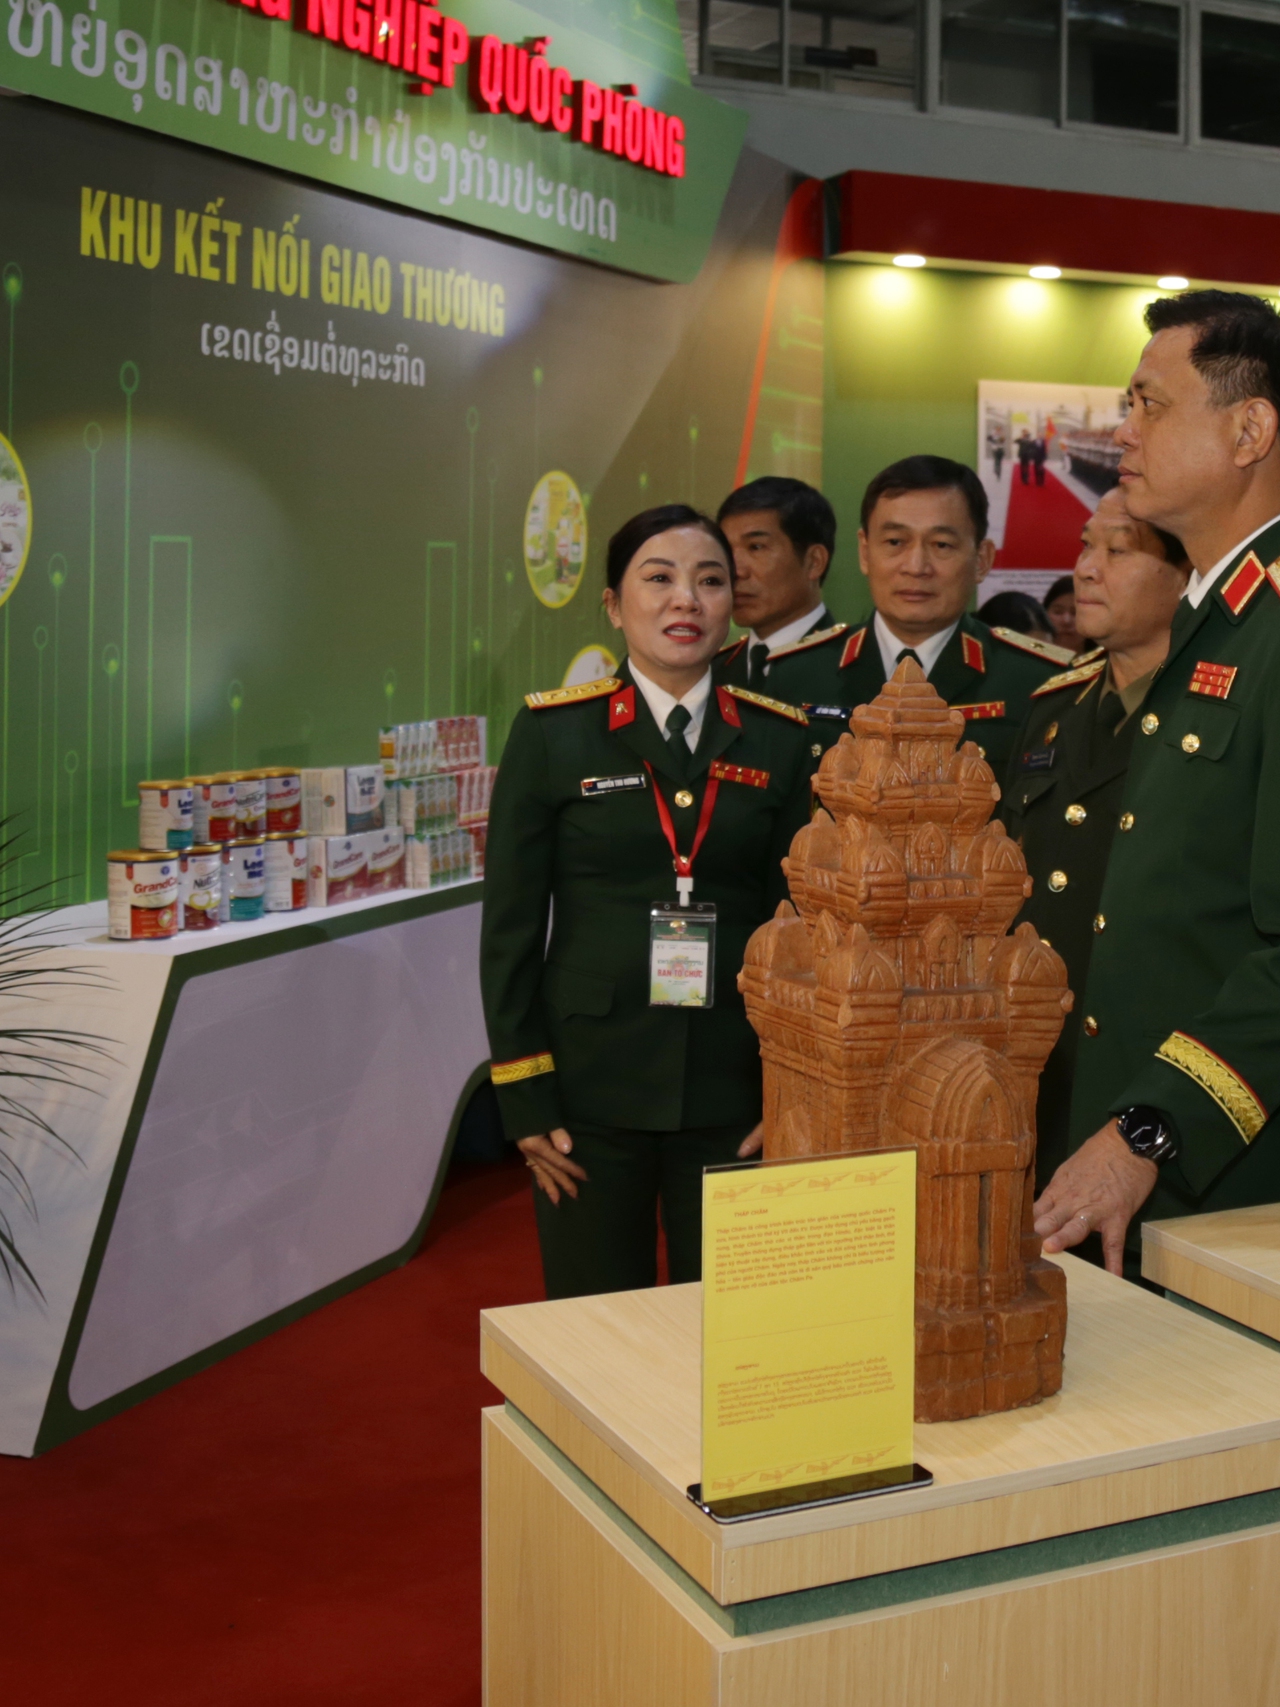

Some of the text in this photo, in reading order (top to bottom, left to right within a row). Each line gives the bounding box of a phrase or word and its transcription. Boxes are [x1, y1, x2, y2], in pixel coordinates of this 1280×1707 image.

[477, 36, 574, 133] QUỐC
[580, 84, 686, 178] PHÒNG
[79, 186, 506, 337] KHU KẾT NỐI GIAO THƯƠNG
